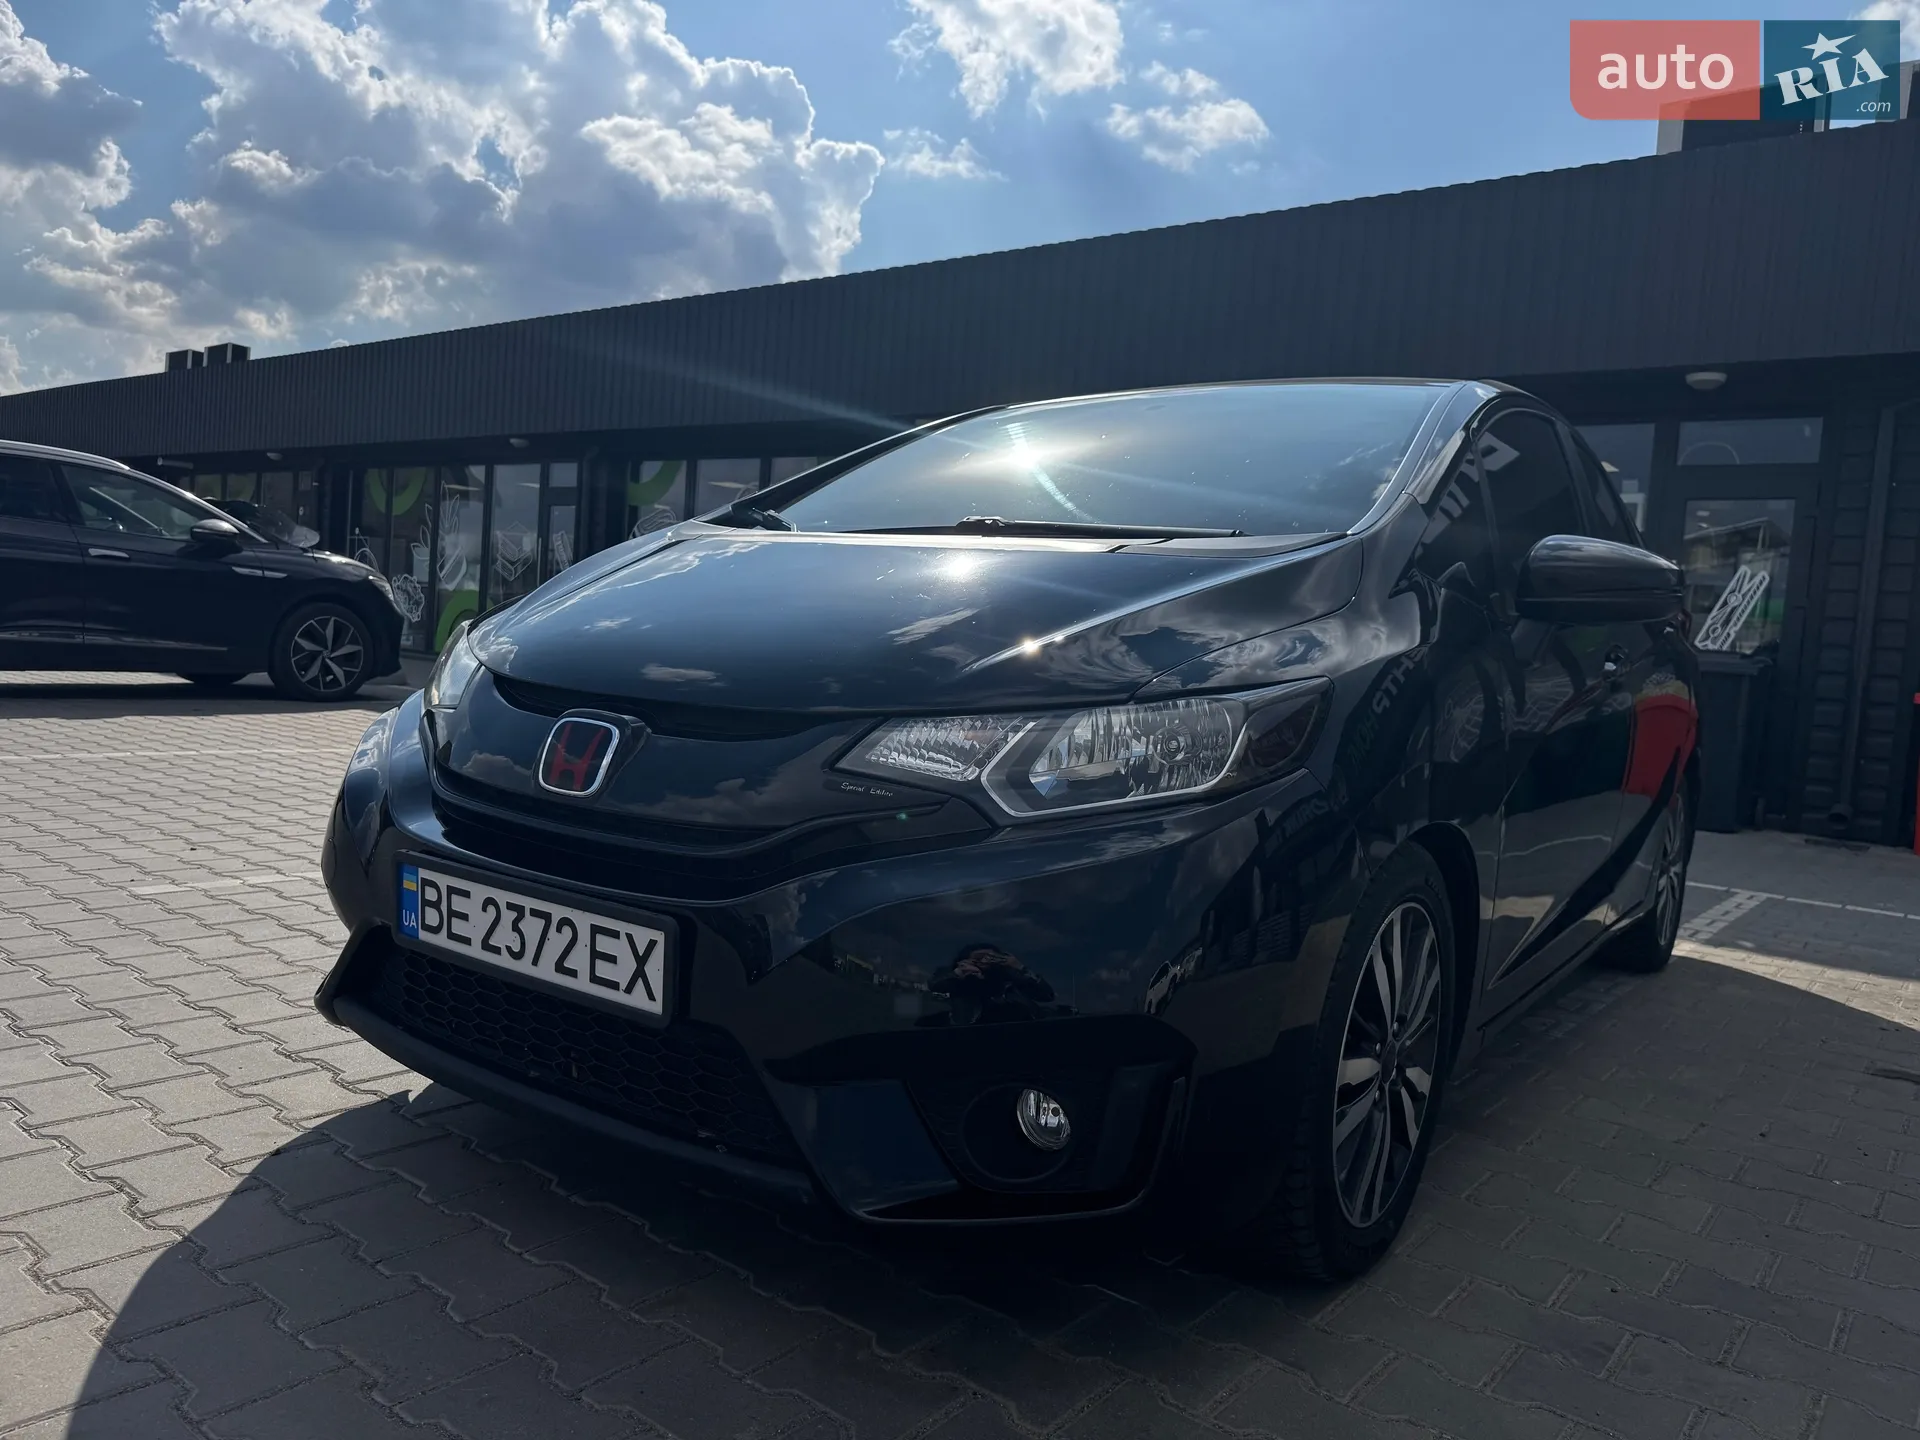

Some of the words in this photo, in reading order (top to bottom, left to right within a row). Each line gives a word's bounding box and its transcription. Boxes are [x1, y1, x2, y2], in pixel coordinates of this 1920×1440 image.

[402, 910, 417, 929] UA
[420, 877, 472, 946] BE
[481, 896, 579, 979] 2372
[589, 923, 658, 1002] EX
